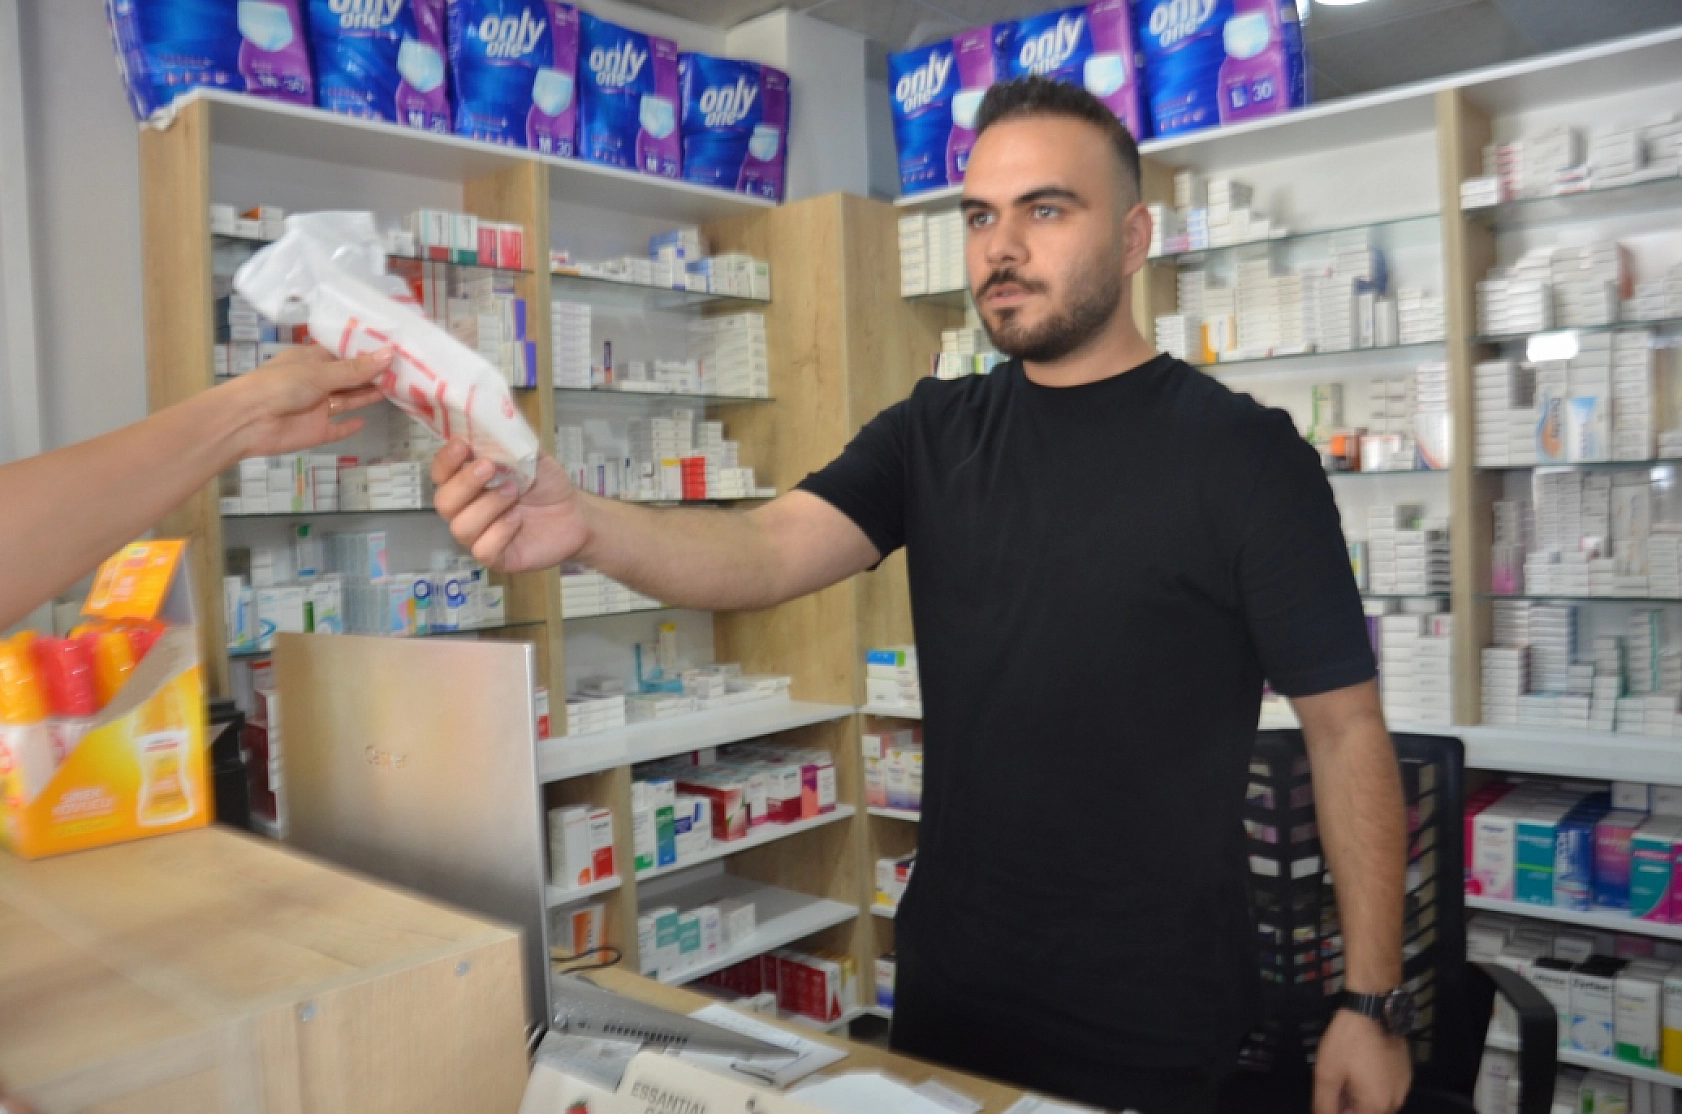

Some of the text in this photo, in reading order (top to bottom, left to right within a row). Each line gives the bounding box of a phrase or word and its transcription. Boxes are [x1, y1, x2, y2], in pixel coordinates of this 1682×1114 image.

[479, 8, 547, 57] only
[1019, 14, 1085, 69] only
[1160, 18, 1196, 47] one
[486, 41, 521, 58] one
[589, 40, 648, 82] only
[596, 71, 625, 87] one
[895, 50, 954, 103] only
[700, 75, 758, 117] only
[904, 90, 932, 112] one
[1253, 82, 1273, 103] 30
[705, 111, 735, 127] one
